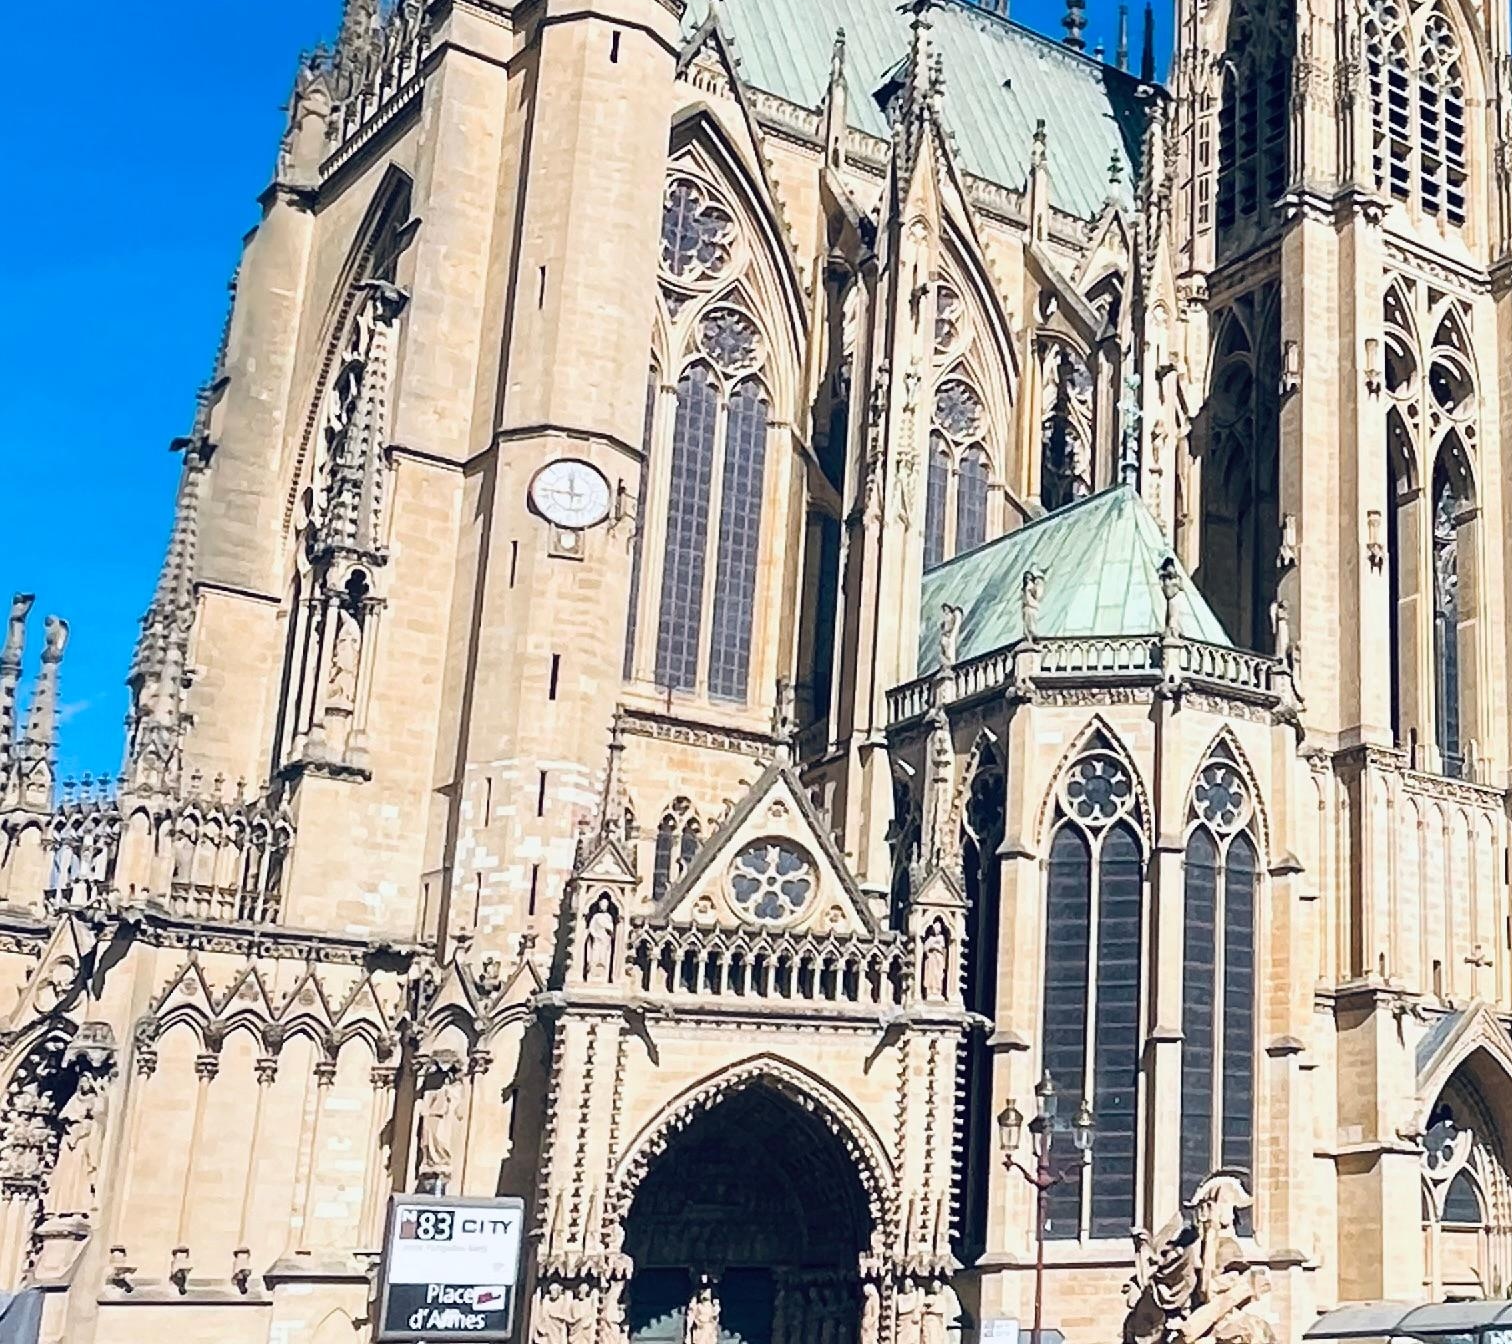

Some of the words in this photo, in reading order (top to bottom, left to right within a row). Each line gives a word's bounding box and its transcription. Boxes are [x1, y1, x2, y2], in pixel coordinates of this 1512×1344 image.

[417, 1212, 452, 1240] 83
[462, 1220, 513, 1234] CITY
[426, 1284, 474, 1304] Place
